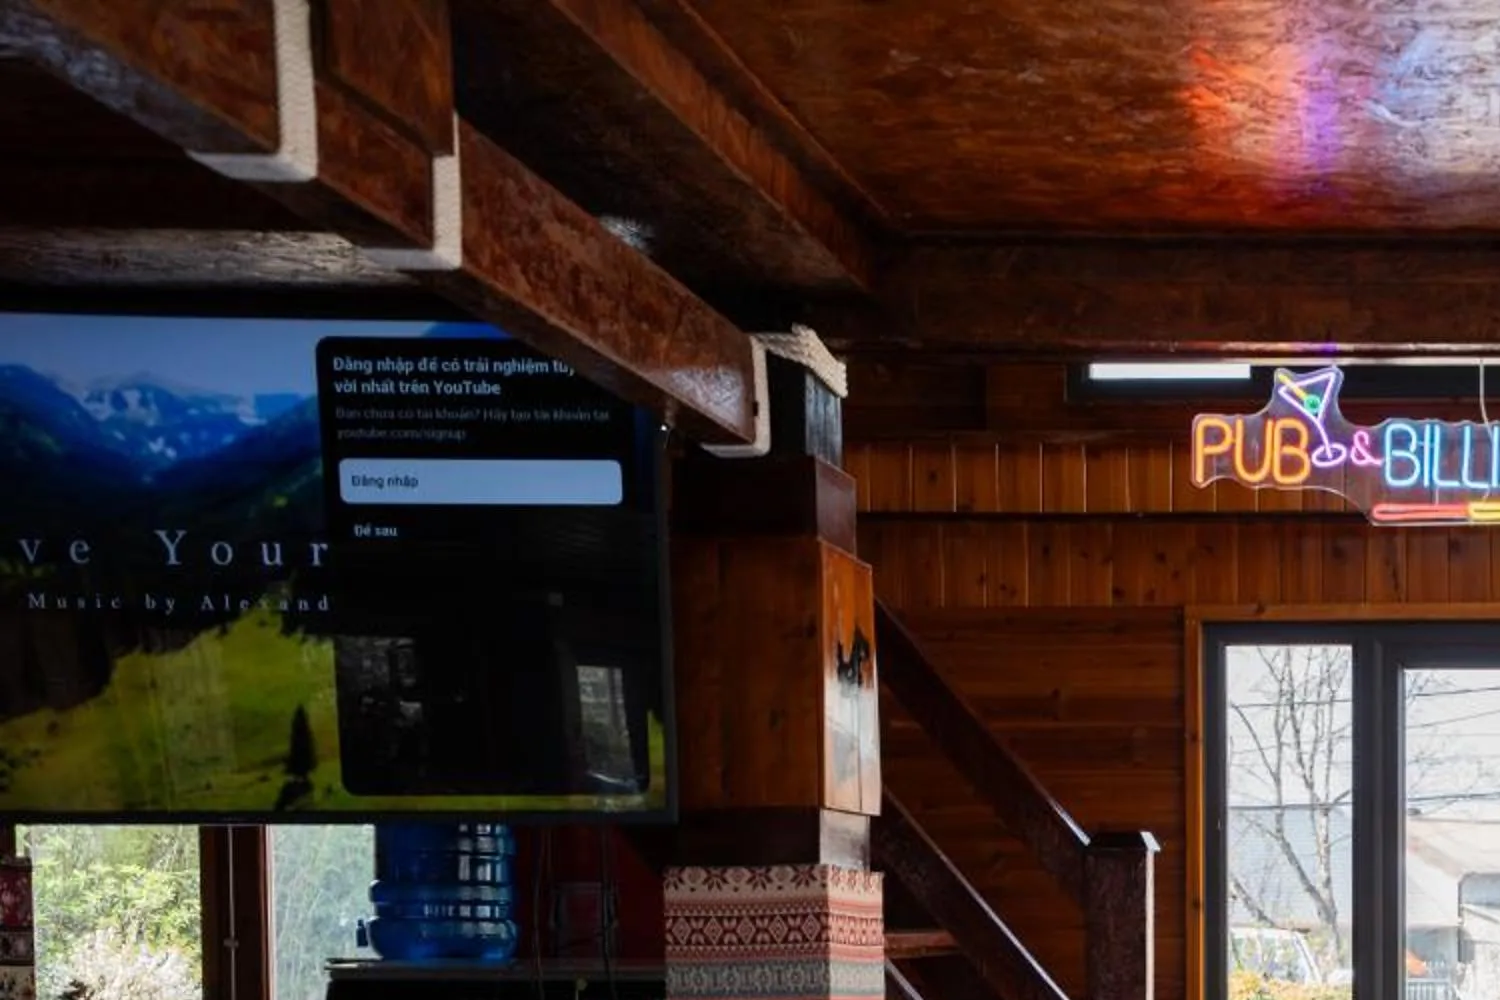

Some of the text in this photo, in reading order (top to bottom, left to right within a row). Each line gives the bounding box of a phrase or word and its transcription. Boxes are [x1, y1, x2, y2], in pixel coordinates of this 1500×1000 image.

[433, 379, 502, 395] YouTube
[1193, 418, 1312, 486] PUB
[1349, 430, 1384, 465] &
[154, 529, 329, 566] Your
[28, 593, 122, 610] Music
[145, 594, 176, 615] by
